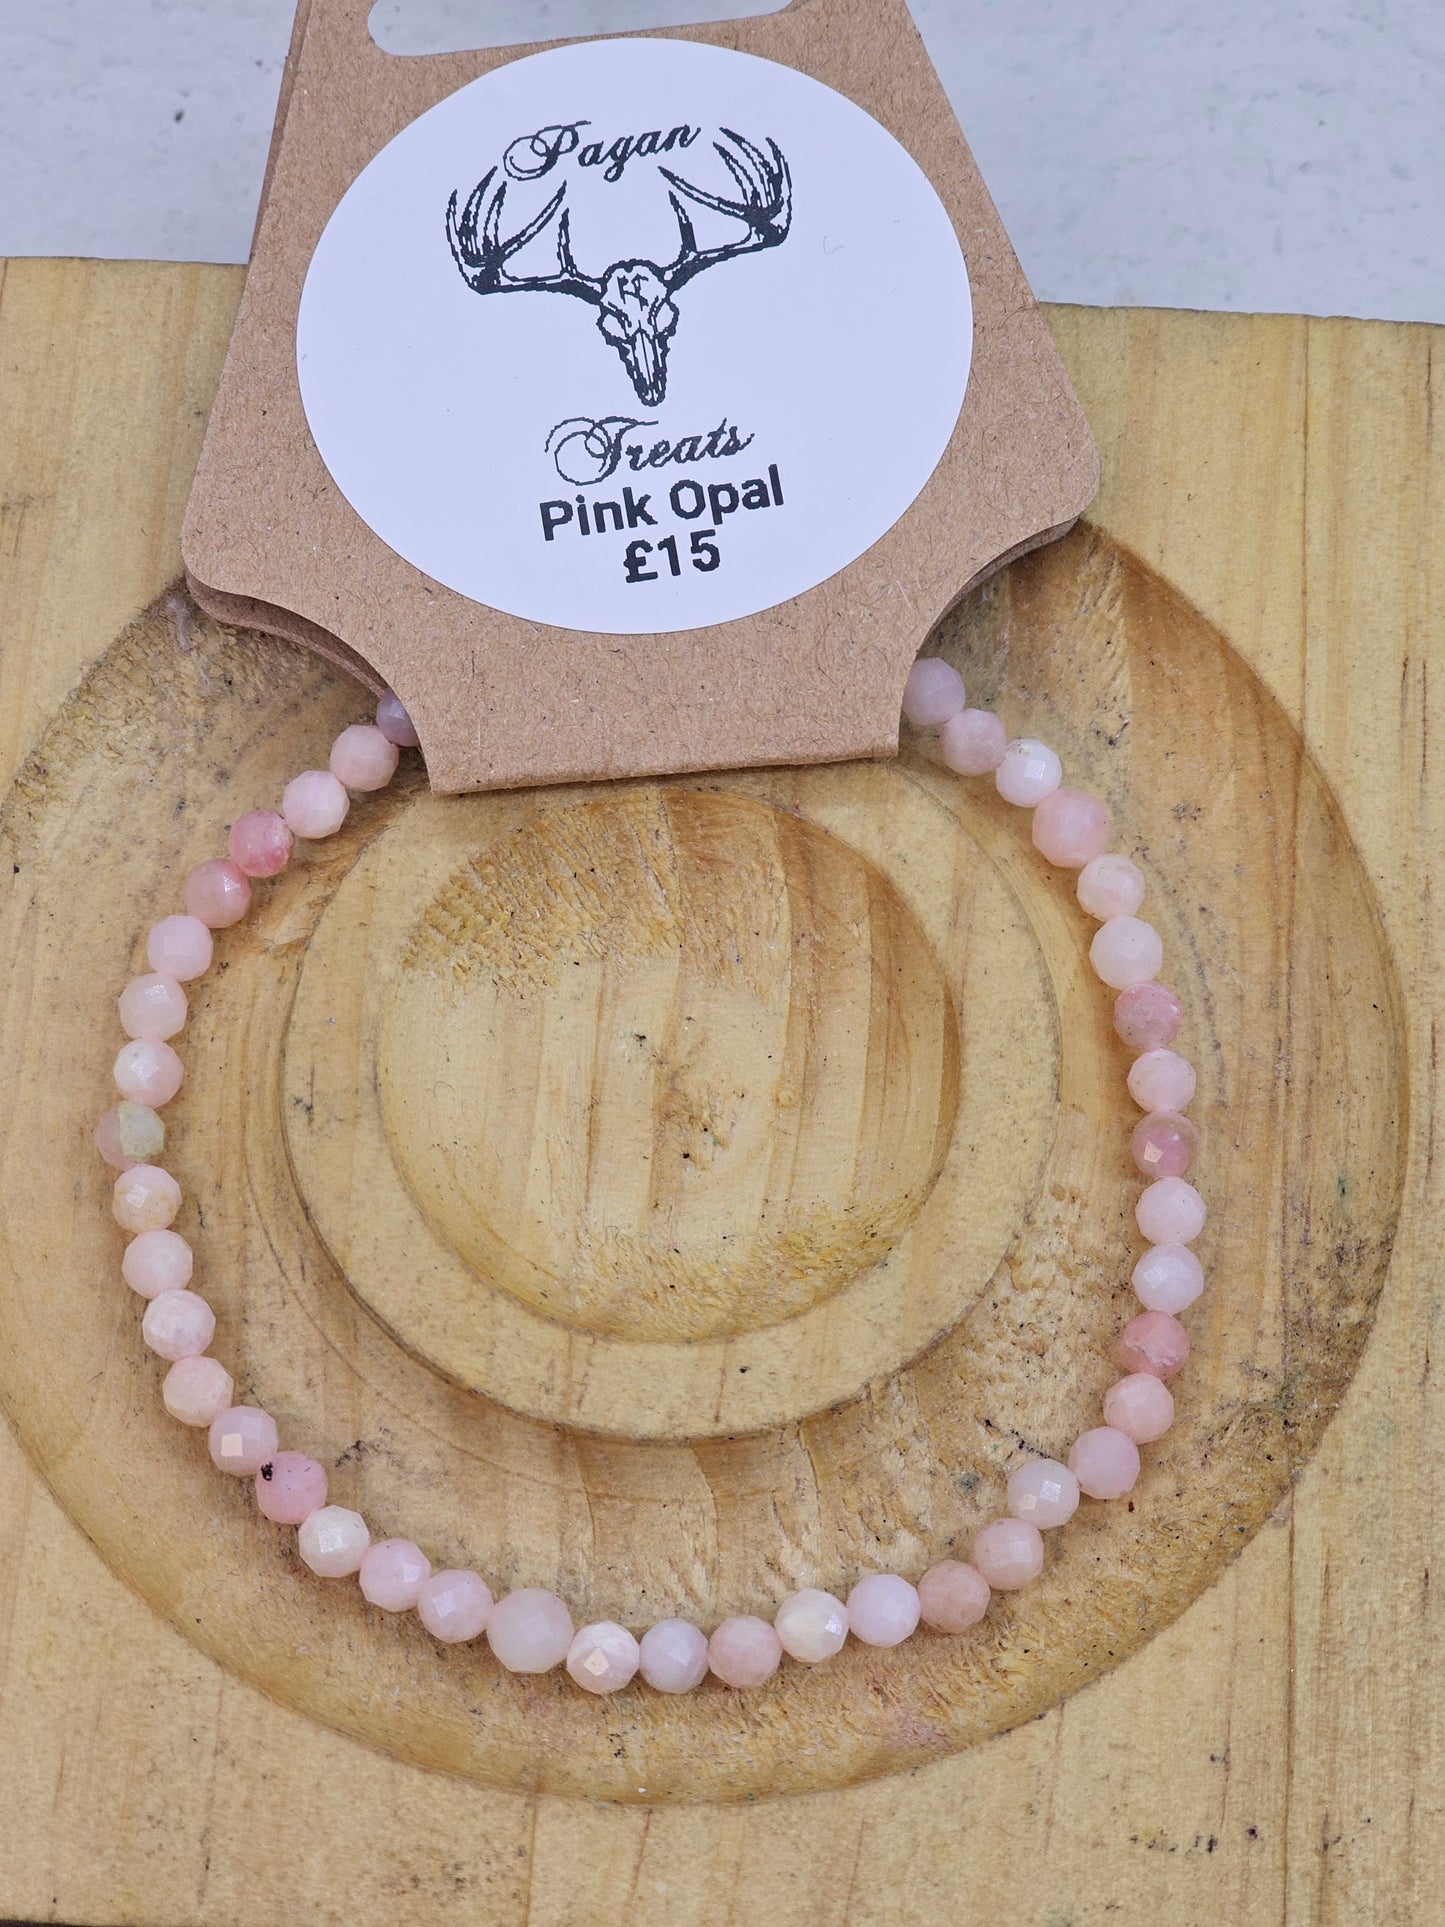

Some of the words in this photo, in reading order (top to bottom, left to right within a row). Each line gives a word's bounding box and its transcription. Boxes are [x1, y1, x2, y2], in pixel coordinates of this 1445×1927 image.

[503, 120, 702, 183] Pagan
[544, 415, 755, 487] Treats
[539, 486, 659, 542] Pink
[669, 463, 784, 526] Opal
[623, 528, 721, 584] £15
